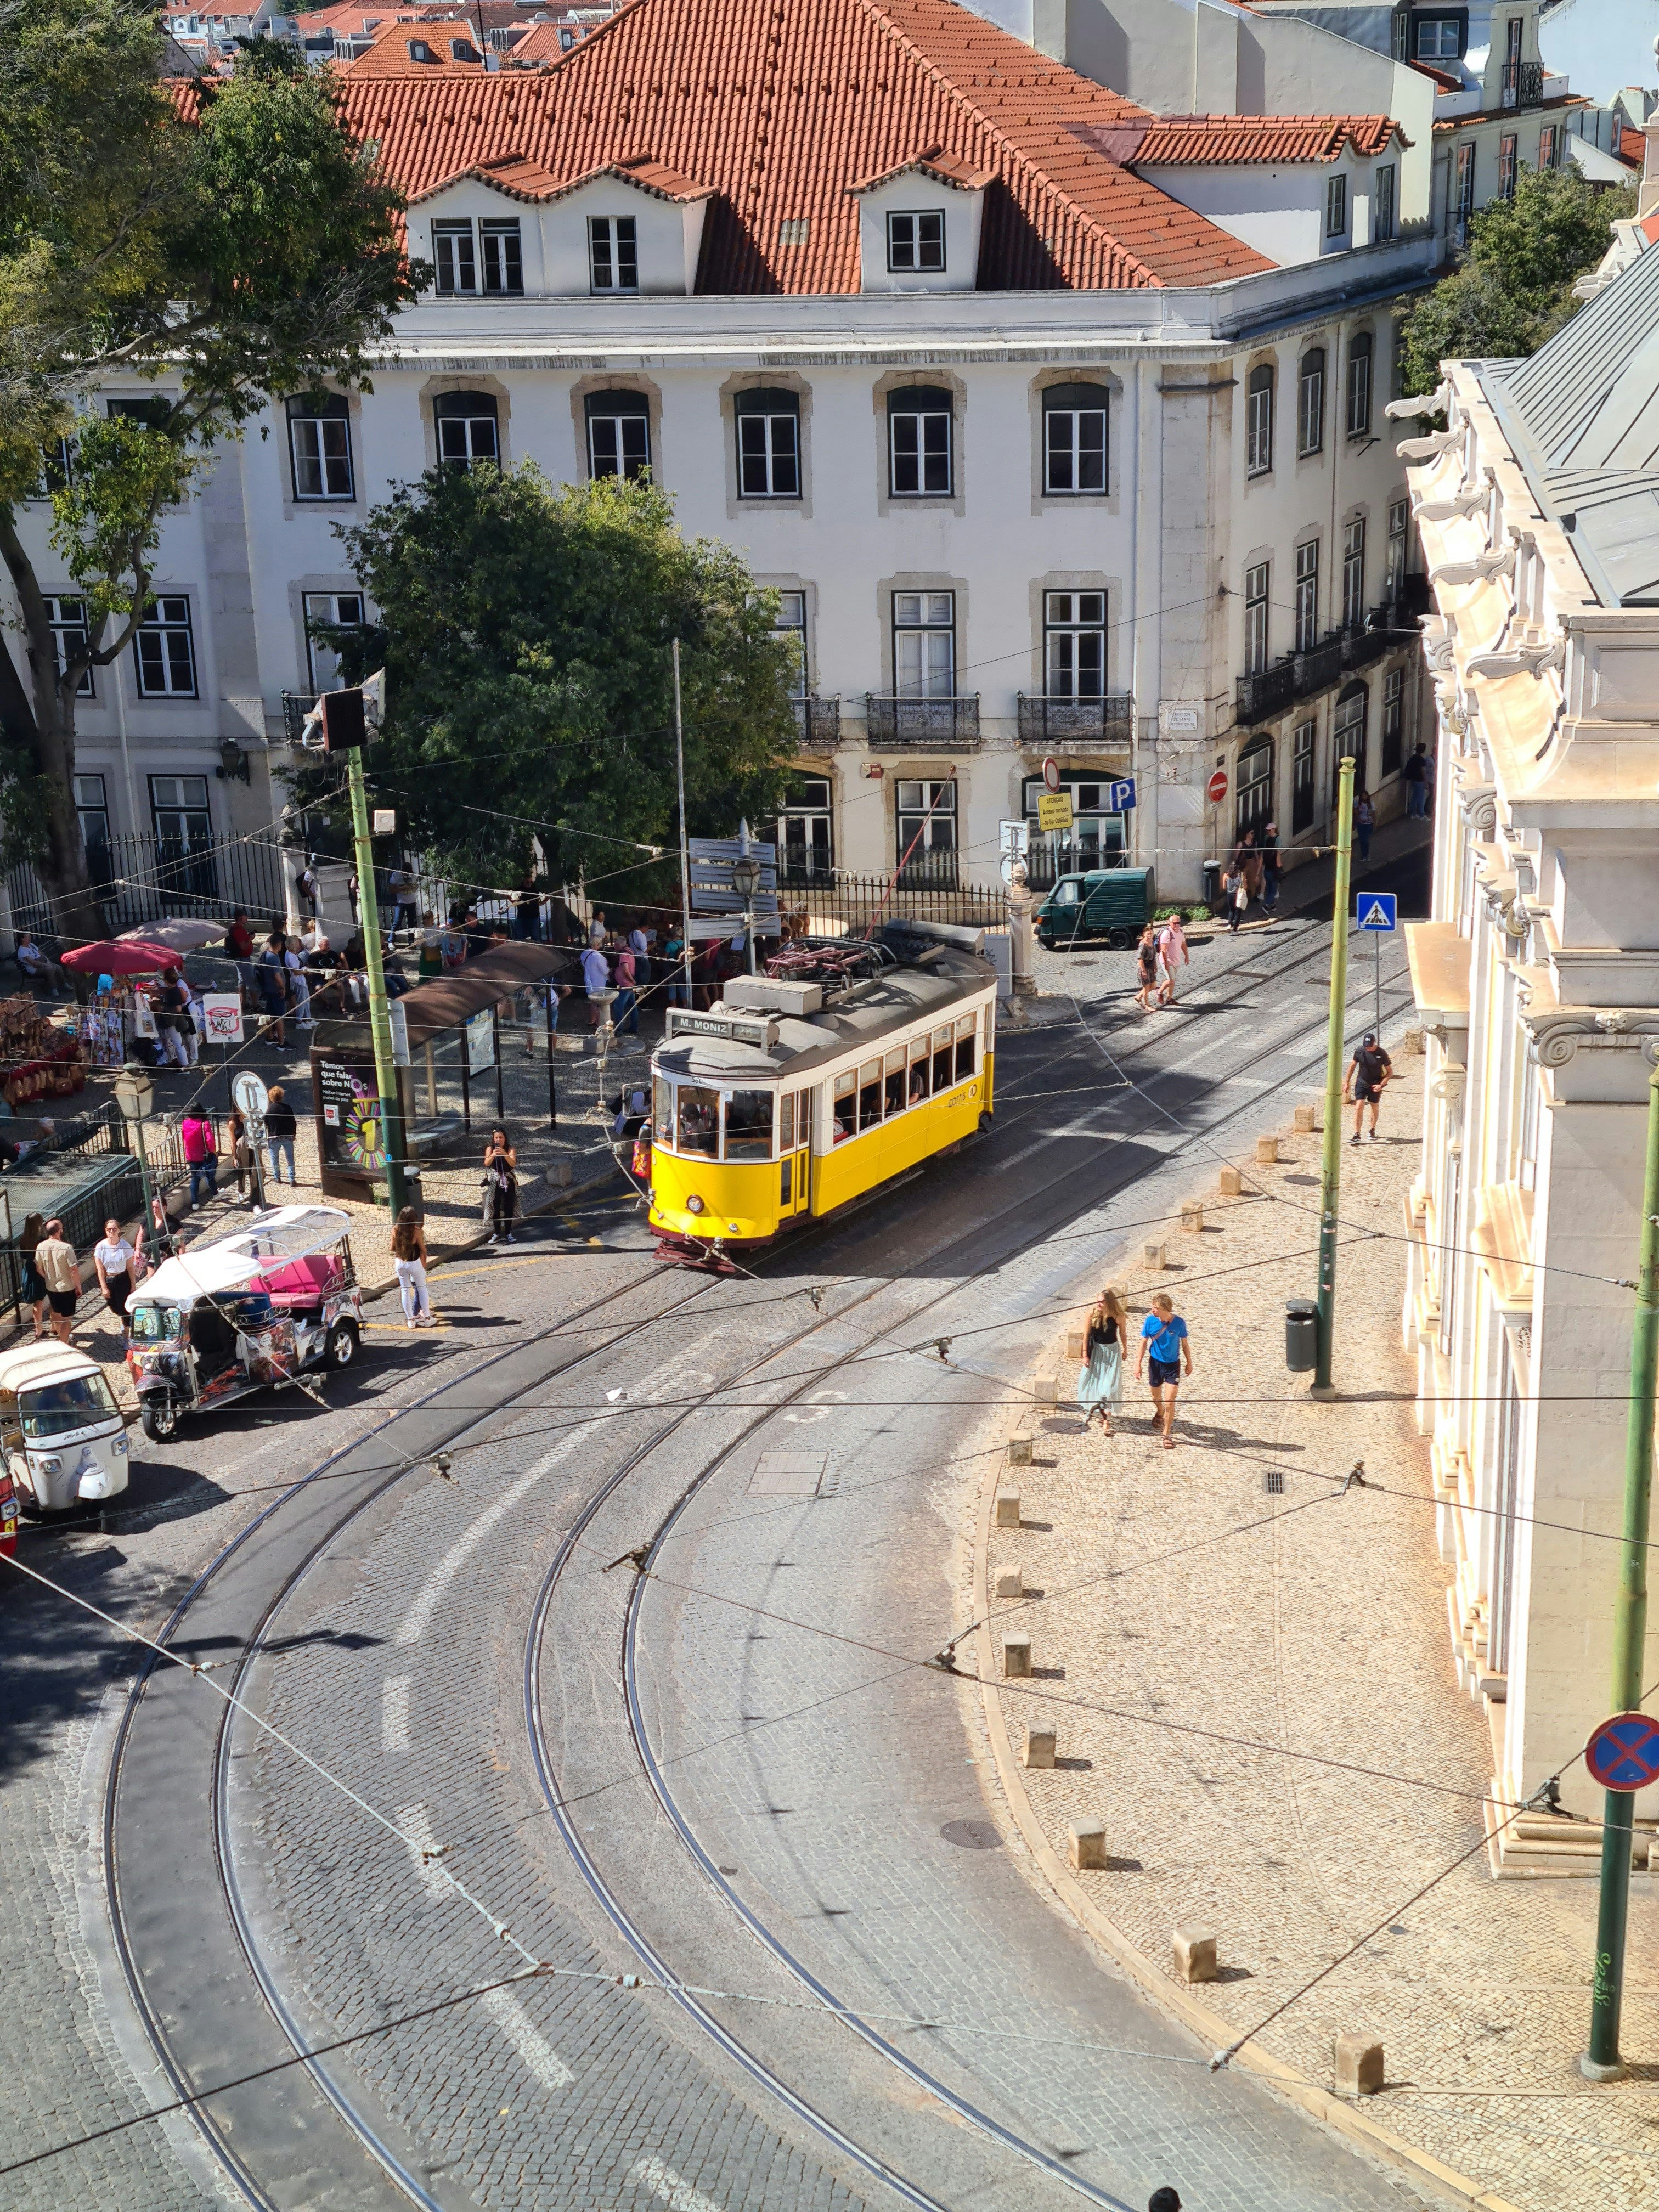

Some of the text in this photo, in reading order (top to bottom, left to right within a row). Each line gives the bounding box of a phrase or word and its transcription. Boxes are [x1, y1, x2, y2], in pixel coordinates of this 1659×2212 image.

[680, 1018, 727, 1033] M. MONIZ
[320, 1060, 345, 1070] Temos
[336, 1070, 352, 1080] falar
[321, 1079, 342, 1087] sobre
